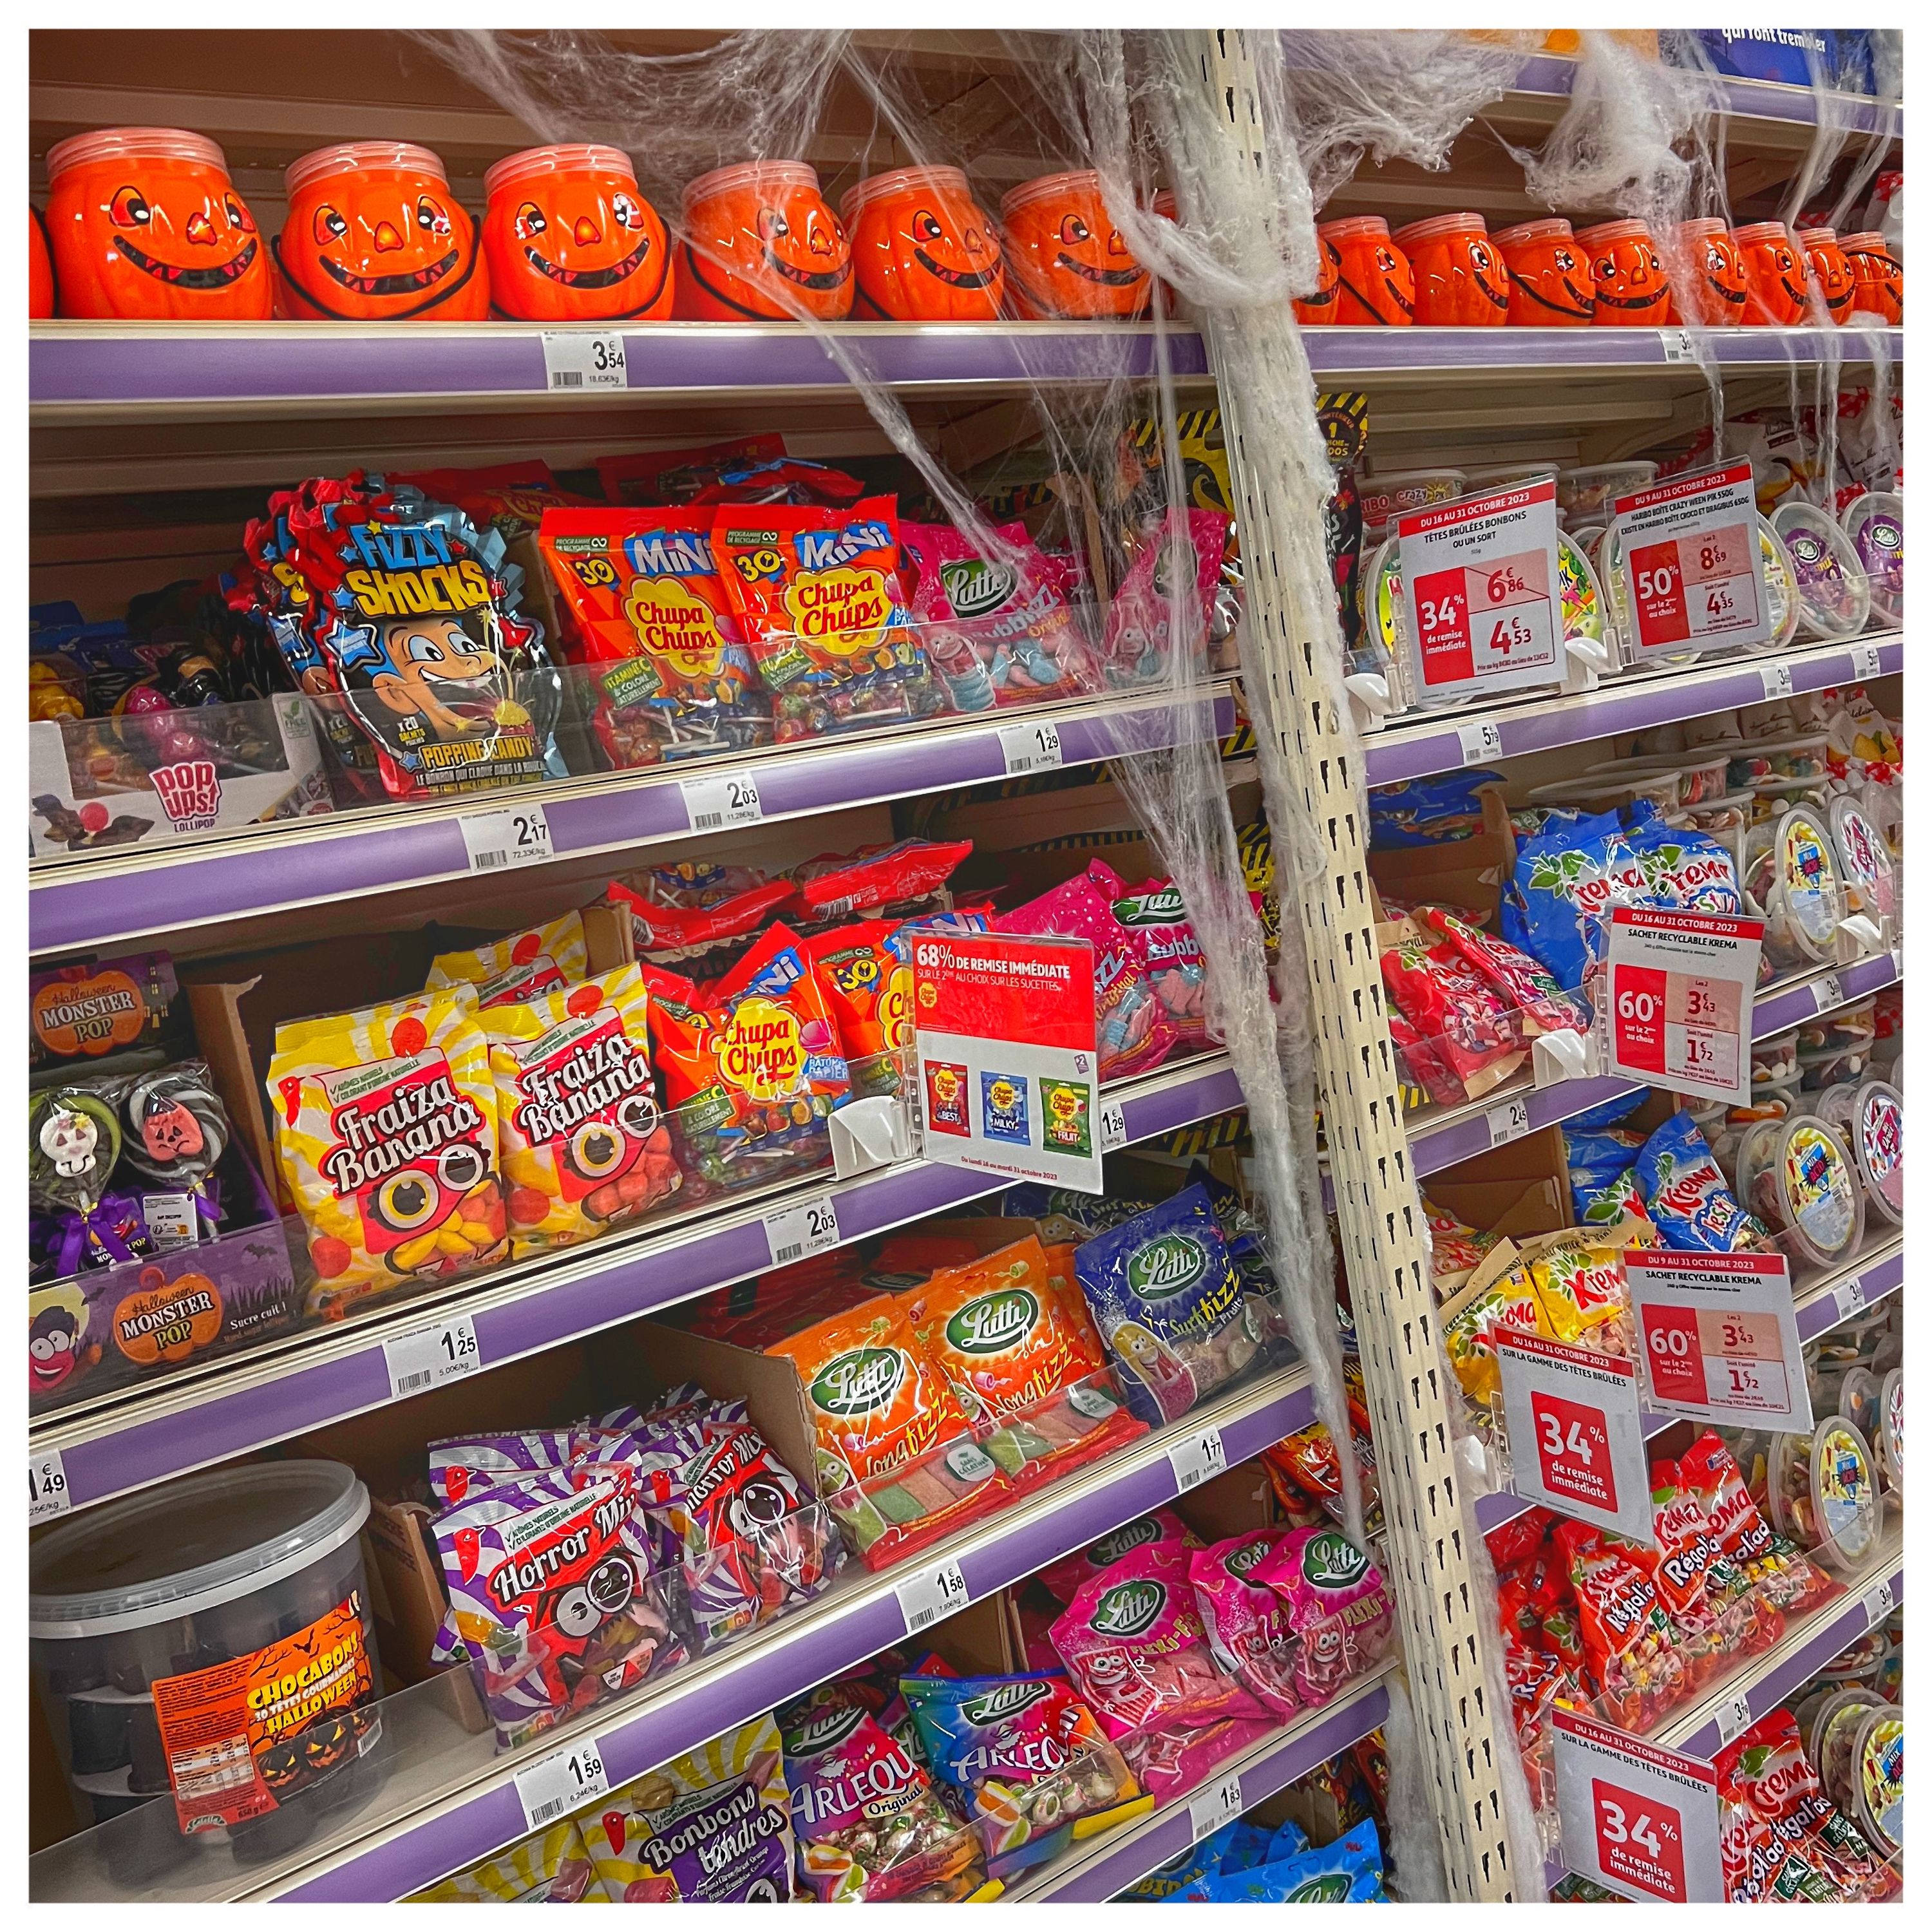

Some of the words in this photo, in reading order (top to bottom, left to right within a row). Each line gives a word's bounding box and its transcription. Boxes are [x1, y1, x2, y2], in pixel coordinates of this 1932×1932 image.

[1631, 510, 1651, 521] HARIBO
[1670, 500, 1687, 511] CRAZY
[1689, 495, 1706, 507] WEEN
[1707, 493, 1716, 502] PIK
[1718, 488, 1734, 499] 550G
[1635, 496, 1645, 505] DU
[1652, 491, 1662, 500] AU
[1672, 480, 1705, 495] OCTOBRE
[1707, 475, 1726, 486] 2023
[1421, 517, 1432, 527] DU
[1434, 515, 1442, 524] 16
[1444, 511, 1455, 522] AU
[1457, 509, 1466, 518] 31
[1468, 498, 1505, 515] OCTOBRE
[1508, 492, 1530, 505] 2023
[1425, 530, 1447, 543] TÊTES
[1449, 522, 1483, 537] BRÛLÉES
[1485, 511, 1526, 528] BONBONS
[1453, 539, 1463, 548] OU
[1465, 536, 1475, 545] UN
[1477, 531, 1496, 542] SORT
[350, 524, 452, 569] FIZZY
[346, 562, 491, 616] SHOCKS
[798, 576, 875, 609] Chupa
[635, 601, 705, 630] Chupa
[802, 596, 883, 638] Chups
[645, 625, 717, 653] Chups
[1426, 640, 1466, 654] immédiate
[1427, 635, 1436, 643] de
[1437, 630, 1463, 641] remise
[423, 742, 484, 769] POPPING
[174, 819, 215, 833] LOLLIPOP
[1628, 929, 1658, 939] SACHET
[1659, 933, 1707, 945] RECYCLABLE
[1709, 938, 1738, 949] KREMA
[1678, 919, 1714, 929] OCTOBRE
[1717, 923, 1738, 932] 2023
[917, 944, 955, 969] 68%
[956, 957, 969, 969] DE
[971, 959, 1007, 973] REMISE
[1009, 960, 1070, 979] IMMÉDIATE
[918, 969, 933, 979] SUR
[956, 973, 965, 982] AU
[967, 974, 989, 984] CHOIX
[990, 976, 1005, 986] SUR
[1006, 978, 1019, 987] LES
[41, 992, 137, 1029] MONSTER
[75, 1018, 113, 1043] POP
[725, 1020, 790, 1049] Chupa
[522, 1032, 633, 1108] Fraiza
[727, 1045, 797, 1084] Chups
[338, 1074, 457, 1150] Fraiza
[518, 1059, 651, 1144] Banana
[942, 1110, 958, 1122] BEST
[994, 1118, 1016, 1130] MILKY
[1057, 1131, 1078, 1142] FRUIT
[327, 1103, 480, 1193] Banana
[998, 1163, 1012, 1171] mardi
[1021, 1167, 1041, 1177] octobre
[1043, 1171, 1057, 1180] 2023
[1139, 1245, 1200, 1293] Lutti
[1646, 1271, 1676, 1279] SACHET
[1678, 1273, 1730, 1282] RECYCLABLE
[1732, 1276, 1762, 1284] KREMA
[1692, 1259, 1730, 1267] OCTOBRE
[120, 1291, 213, 1341] MONSTER
[230, 1311, 259, 1331] Sucre
[261, 1305, 279, 1321] cuit
[961, 1297, 1032, 1346] Lutti
[155, 1321, 193, 1351] POP
[1513, 1336, 1522, 1345] DU
[1524, 1339, 1532, 1348] 16
[1533, 1341, 1544, 1350] AU
[1546, 1344, 1554, 1353] 31
[1555, 1346, 1589, 1362] OCTOBRE
[1590, 1355, 1609, 1367] 2023
[1502, 1348, 1516, 1358] SUR
[1517, 1351, 1526, 1361] LA
[1527, 1354, 1553, 1368] GAMME
[1555, 1361, 1568, 1372] DES
[1569, 1365, 1591, 1378] TÊTES
[1593, 1370, 1626, 1387] BRÛLÉES
[733, 1432, 766, 1466] Mix
[1551, 1471, 1607, 1500] immédiate
[1552, 1461, 1565, 1474] de
[1567, 1467, 1603, 1486] remise
[494, 1526, 589, 1602] Horror
[1096, 1582, 1159, 1631] Lutti
[247, 1631, 358, 1710] CHOCABONS
[255, 1711, 267, 1722] 30
[269, 1695, 301, 1715] TÊTES
[302, 1657, 355, 1700] GOURMANDES
[266, 1671, 357, 1734] HALLOWEEN
[1562, 1732, 1577, 1745] SUR
[1578, 1739, 1589, 1750] LA
[1591, 1743, 1622, 1762] GAMME
[1624, 1755, 1639, 1768] DES
[1641, 1761, 1667, 1778] TÊTES
[1669, 1772, 1708, 1793] BRÛLÉES
[1575, 1724, 1586, 1735] DU
[1589, 1728, 1598, 1739] 16
[1600, 1732, 1612, 1744] AU
[1613, 1737, 1624, 1748] 31
[1625, 1741, 1665, 1763] OCTOBRE
[1666, 1756, 1689, 1772] 2023
[867, 1785, 923, 1817] Original
[646, 1784, 755, 1869] Bonbons
[1610, 1857, 1675, 1893] immédiate
[1612, 1847, 1627, 1861] de
[1629, 1854, 1671, 1880] remise
